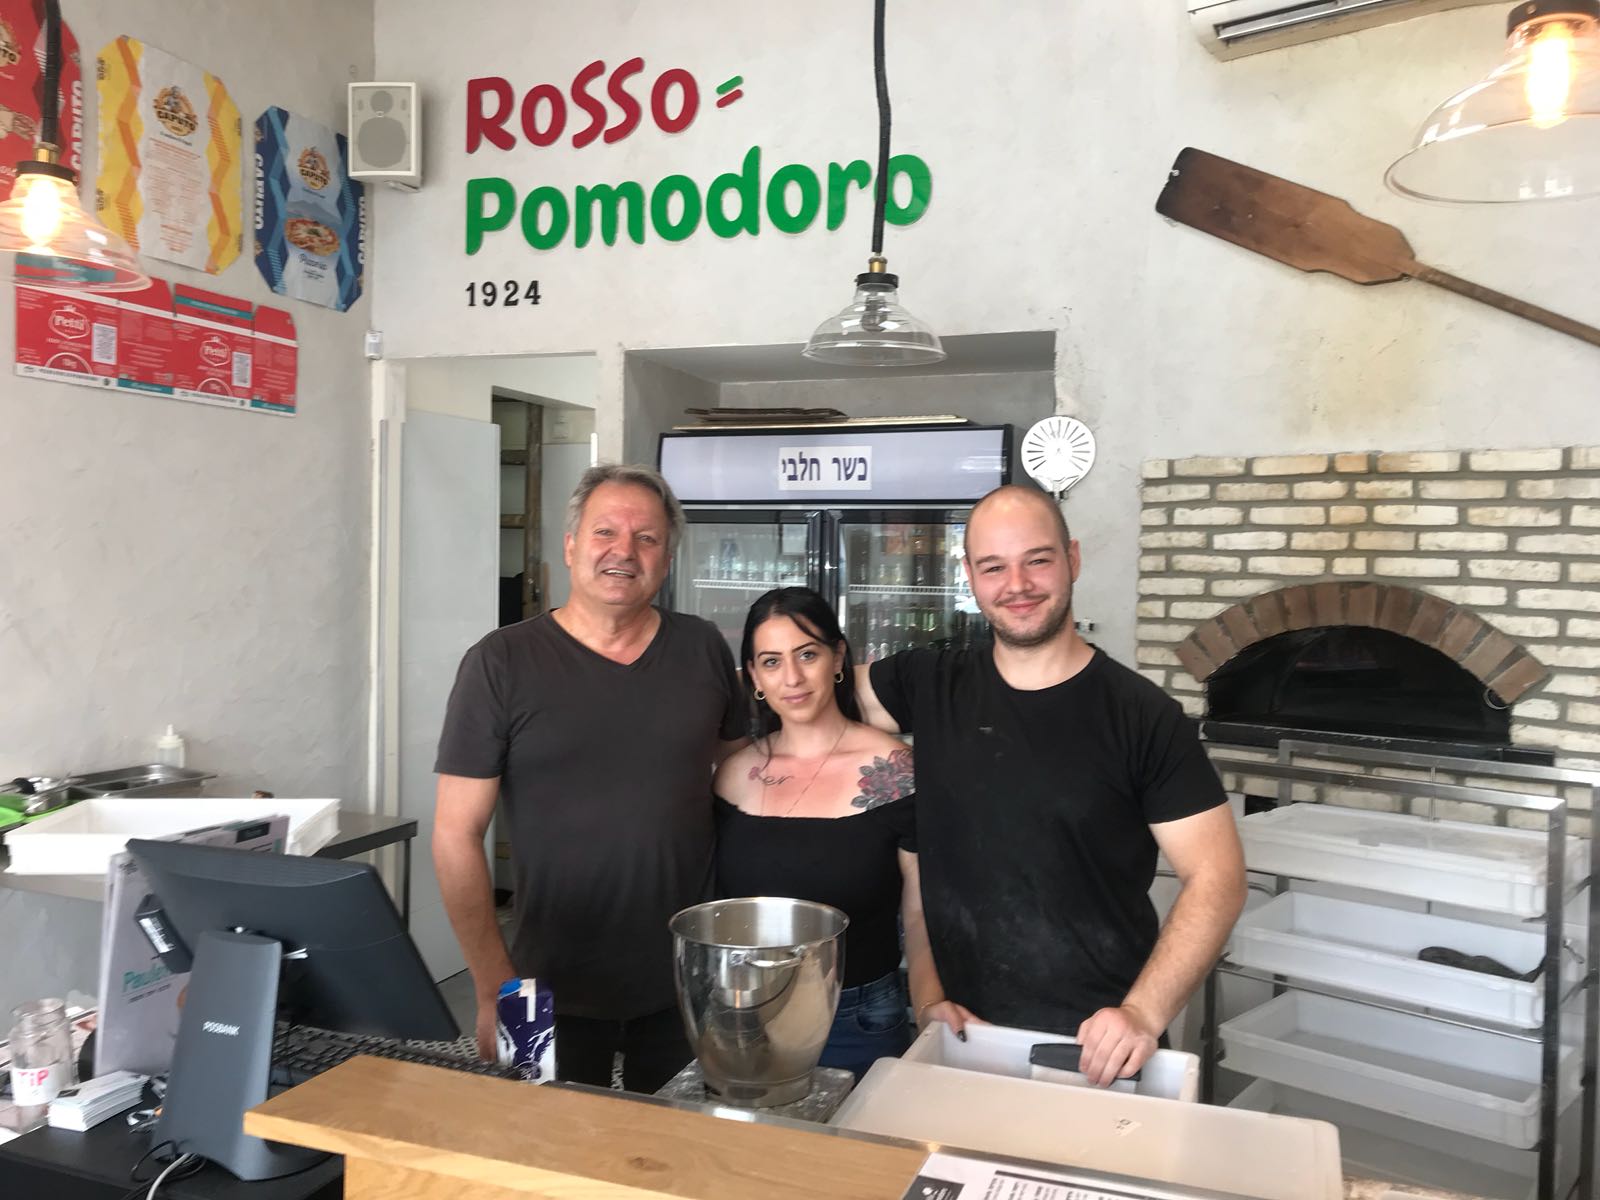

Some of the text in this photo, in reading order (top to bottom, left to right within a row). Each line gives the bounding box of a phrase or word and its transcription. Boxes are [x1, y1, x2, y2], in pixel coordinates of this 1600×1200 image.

[465, 145, 932, 255] Pomodoro
[465, 280, 542, 307] 1924
[781, 451, 868, 482] כשר חלבי
[202, 1021, 241, 1036] POSBANK
